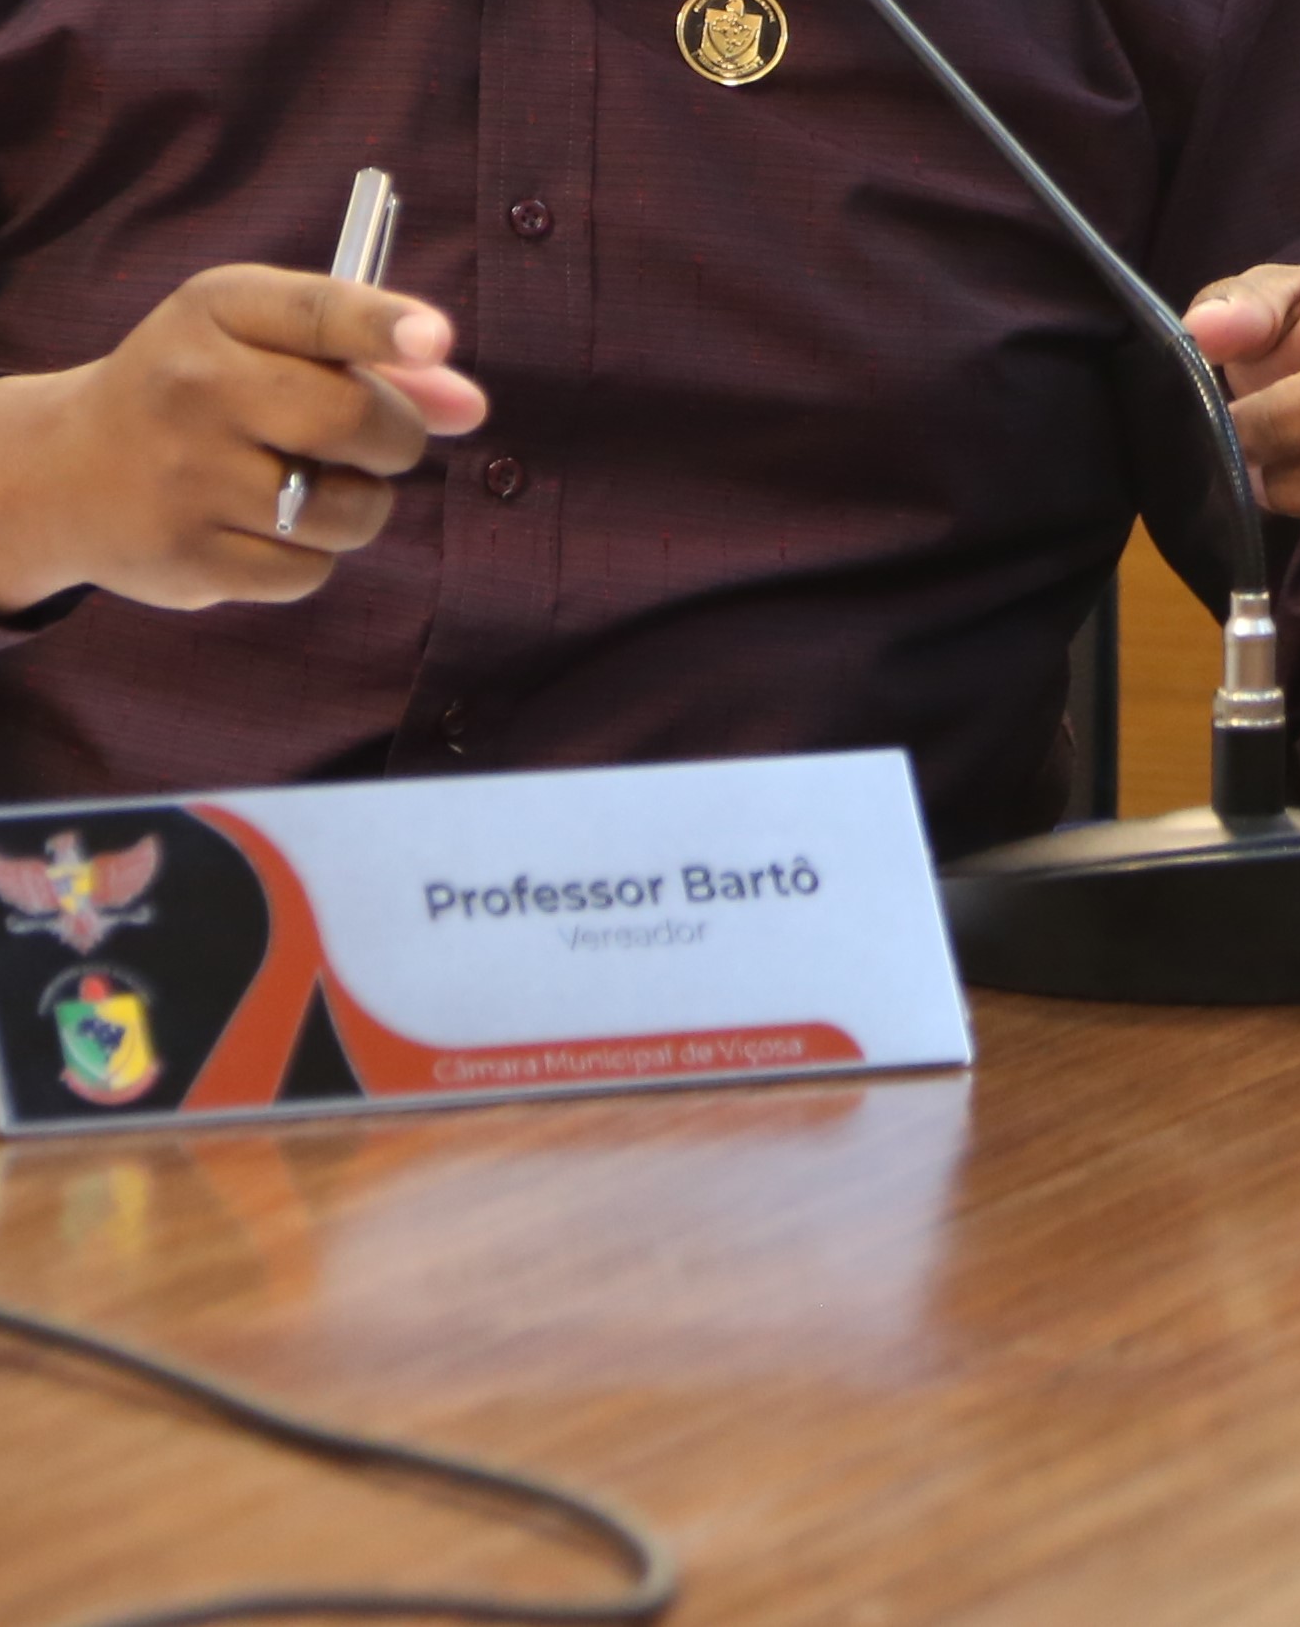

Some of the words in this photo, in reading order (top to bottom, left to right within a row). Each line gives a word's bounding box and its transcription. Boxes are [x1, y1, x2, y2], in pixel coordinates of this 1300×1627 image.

[424, 874, 664, 921] Professor
[681, 856, 820, 904] Bartô
[558, 918, 708, 951] Vereador
[544, 1041, 673, 1075] Municipal
[717, 1037, 804, 1067] Viçosa
